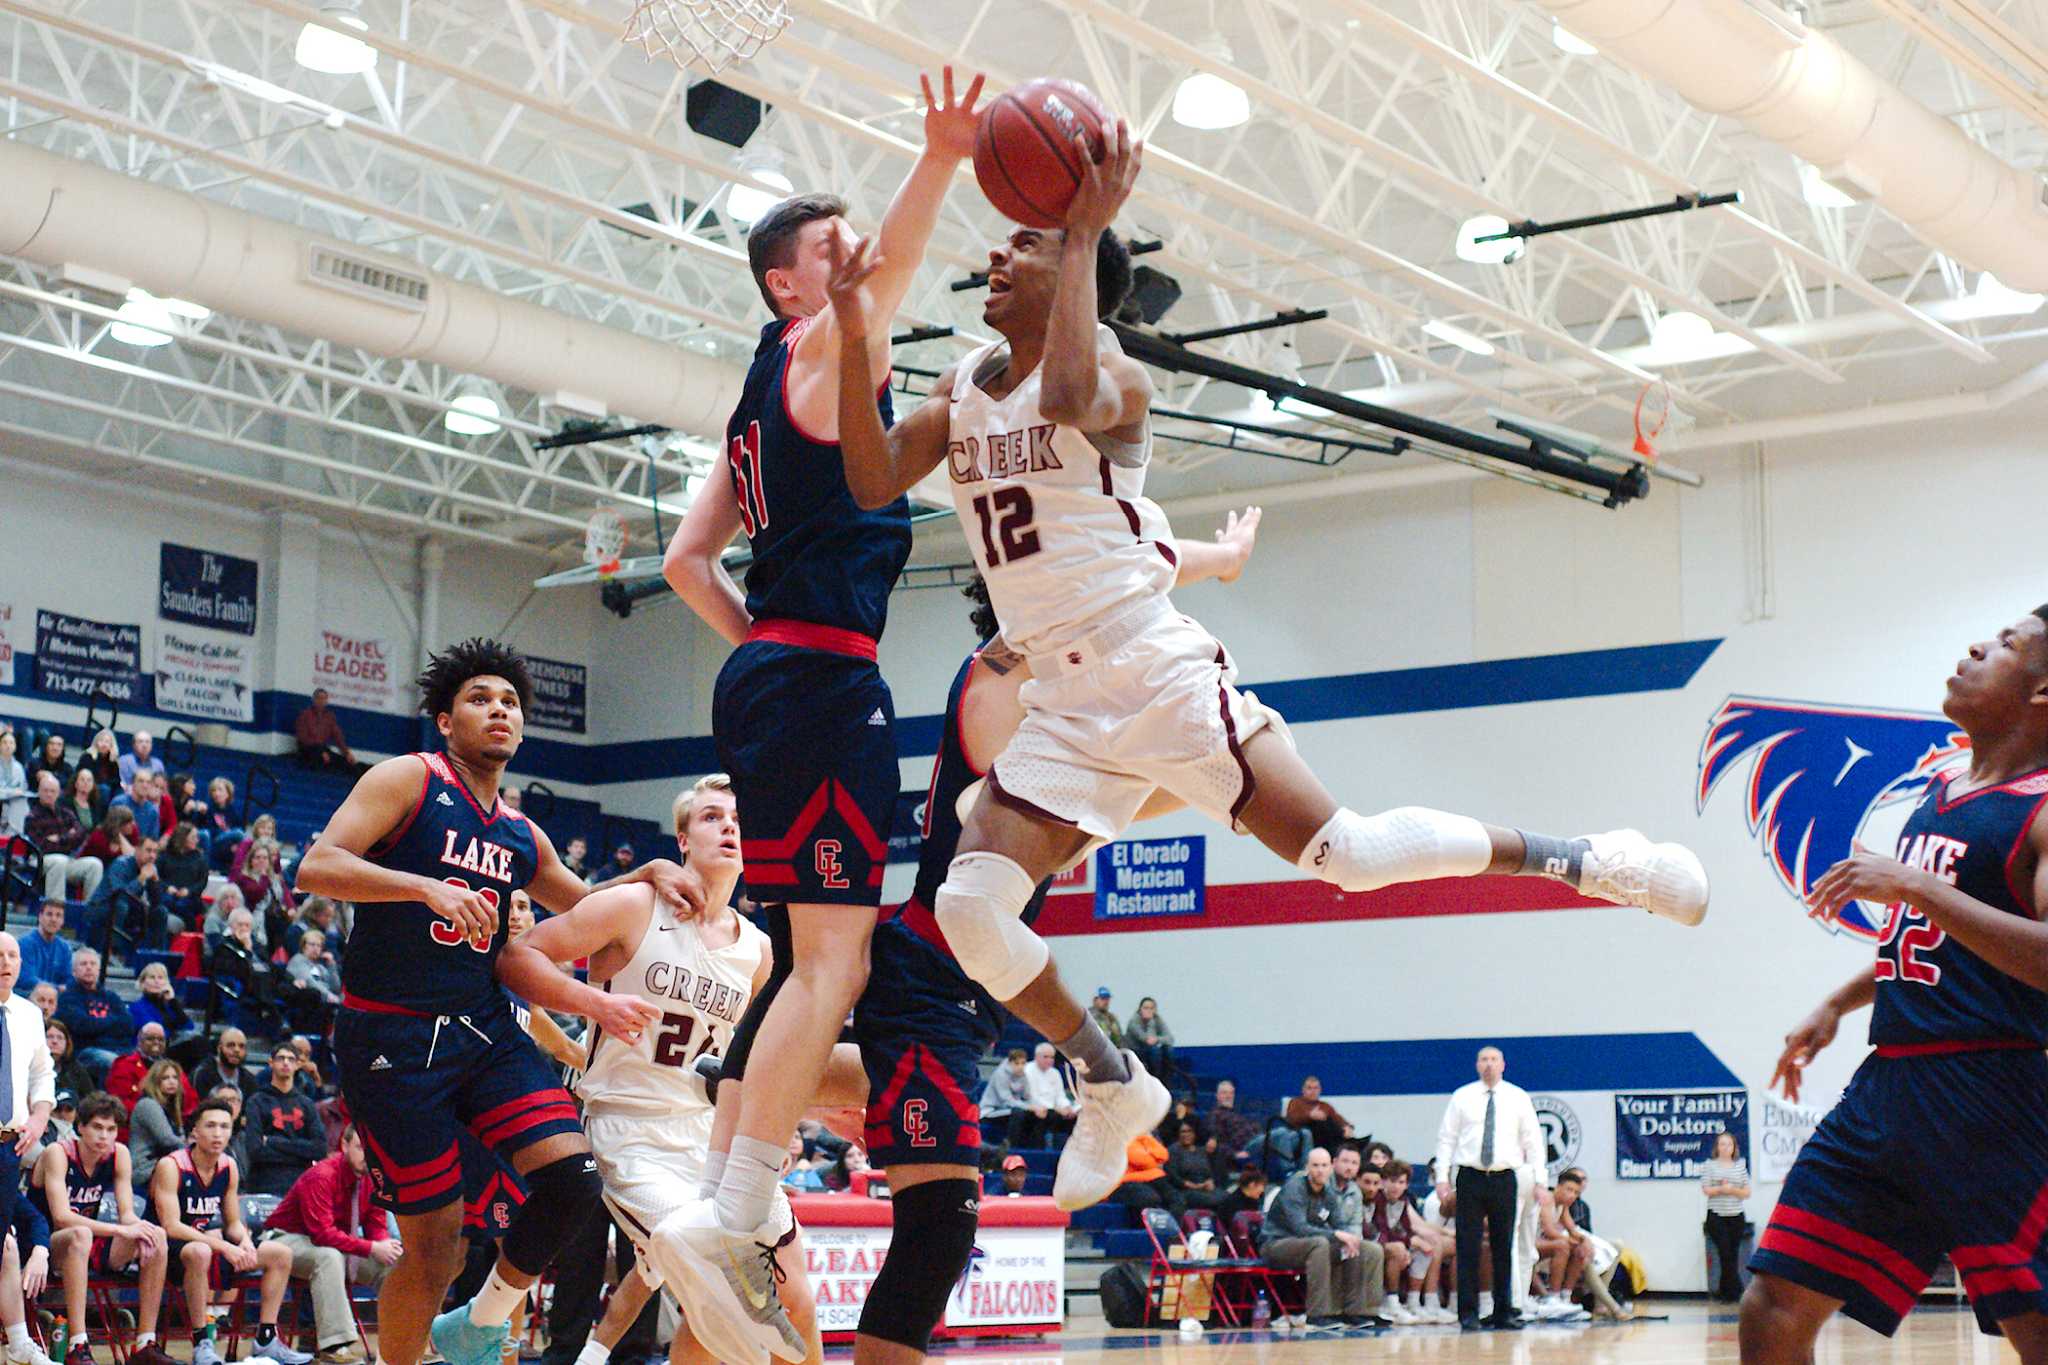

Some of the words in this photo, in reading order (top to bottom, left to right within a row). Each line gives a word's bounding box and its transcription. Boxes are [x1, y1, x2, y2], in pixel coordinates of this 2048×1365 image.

[949, 423, 1063, 484] CREEK
[973, 486, 1041, 568] 12
[201, 554, 224, 584] The
[162, 580, 213, 618] Saunders
[214, 592, 256, 625] Family
[89, 644, 135, 667] Plumbing
[322, 630, 386, 659] TRAVEL
[314, 653, 387, 682] LEADERS
[183, 687, 222, 701] FALCON
[441, 829, 514, 884] LAKE
[1112, 843, 1128, 867] El
[1132, 839, 1190, 866] Dorado
[1115, 865, 1185, 891] Mexican
[1106, 888, 1197, 916] Restaurant
[645, 961, 744, 1023] CREEK
[1616, 1095, 1668, 1116] Your
[1672, 1093, 1747, 1118] Family
[1639, 1115, 1727, 1136] Doktors
[1663, 1140, 1702, 1154] Support
[1620, 1158, 1652, 1178] Clear
[1653, 1158, 1682, 1178] Lake
[66, 1184, 102, 1204] LAKE
[186, 1196, 221, 1215] LAKE
[810, 1233, 853, 1245] WELCOME
[856, 1232, 869, 1245] TO
[995, 1257, 1018, 1267] HOME
[1019, 1256, 1030, 1267] OF
[1031, 1256, 1046, 1267] THE
[969, 1280, 1058, 1319] FALCONS
